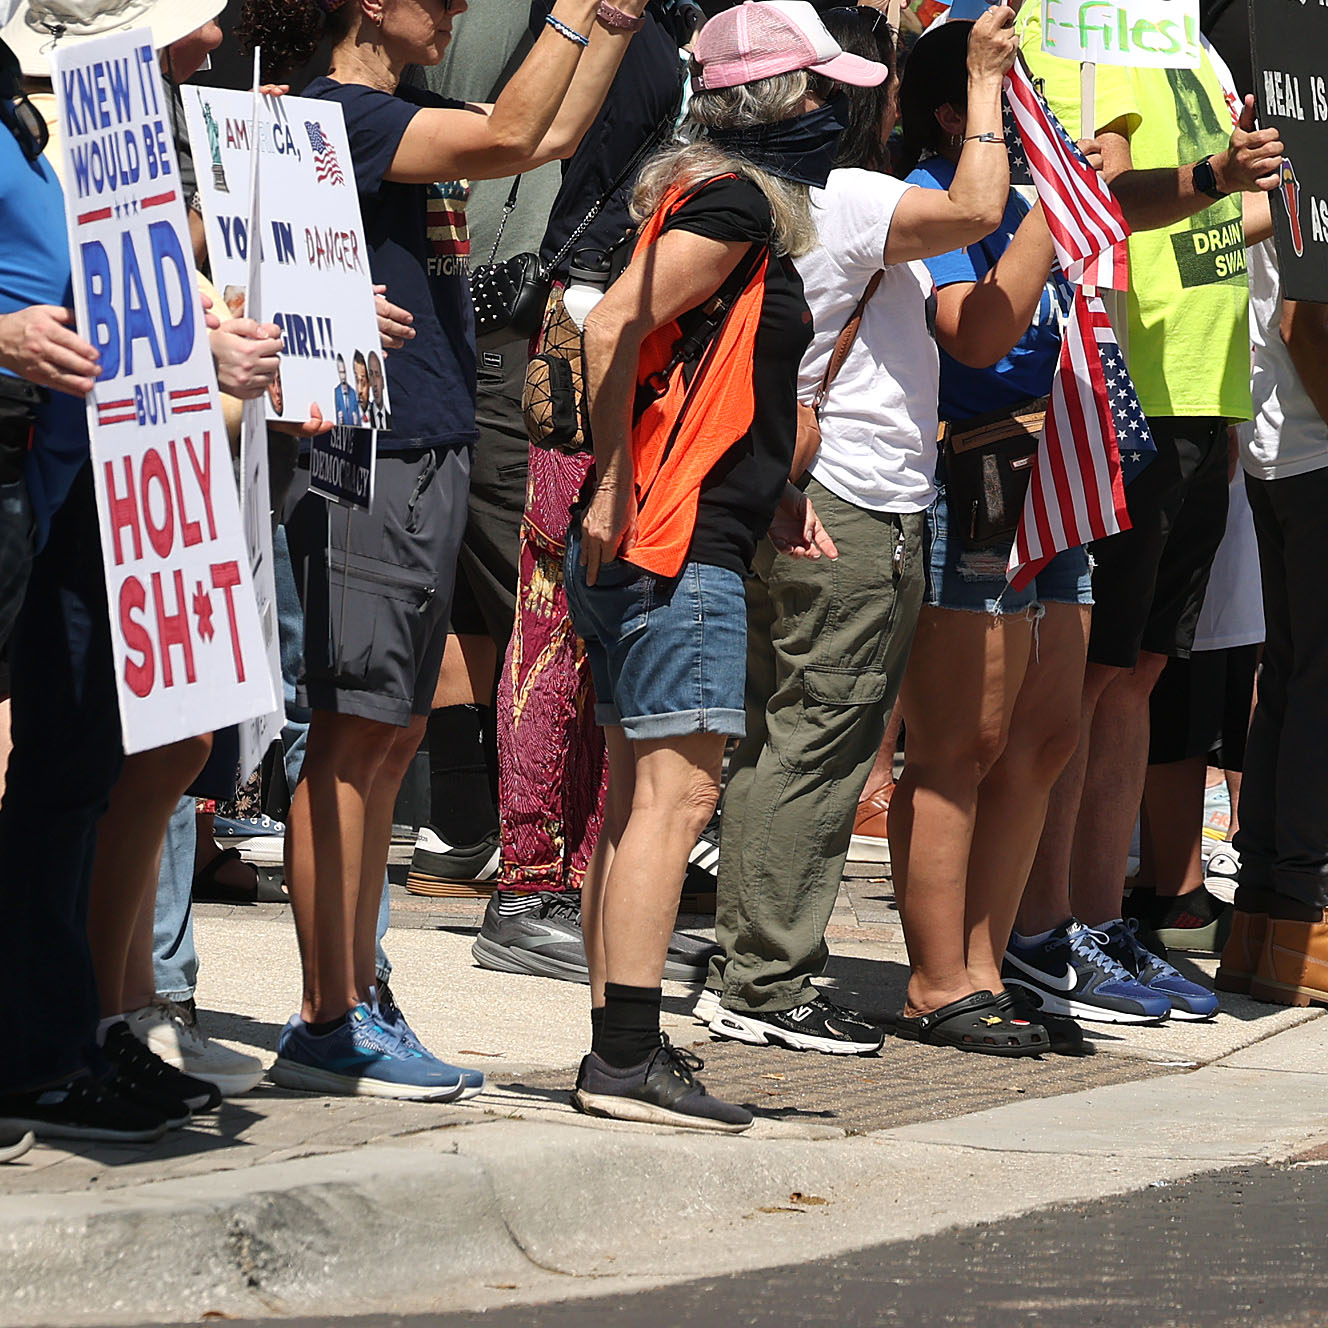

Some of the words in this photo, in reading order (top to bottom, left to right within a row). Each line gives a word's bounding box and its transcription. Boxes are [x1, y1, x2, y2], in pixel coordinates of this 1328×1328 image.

[60, 56, 132, 137] KNEW
[137, 44, 161, 118] IT
[1263, 70, 1305, 121] MEAL
[1310, 76, 1327, 122] IS
[70, 127, 140, 201] WOULD
[143, 120, 171, 178] BE
[271, 221, 297, 265] IN
[305, 225, 366, 277] DANGER
[1192, 224, 1241, 255] DRAIN
[80, 219, 194, 383] BAD
[273, 312, 336, 361] GIRL!!
[134, 379, 166, 427] BUT
[103, 430, 219, 568] HOLY
[312, 456, 370, 497] DEMOCRACY
